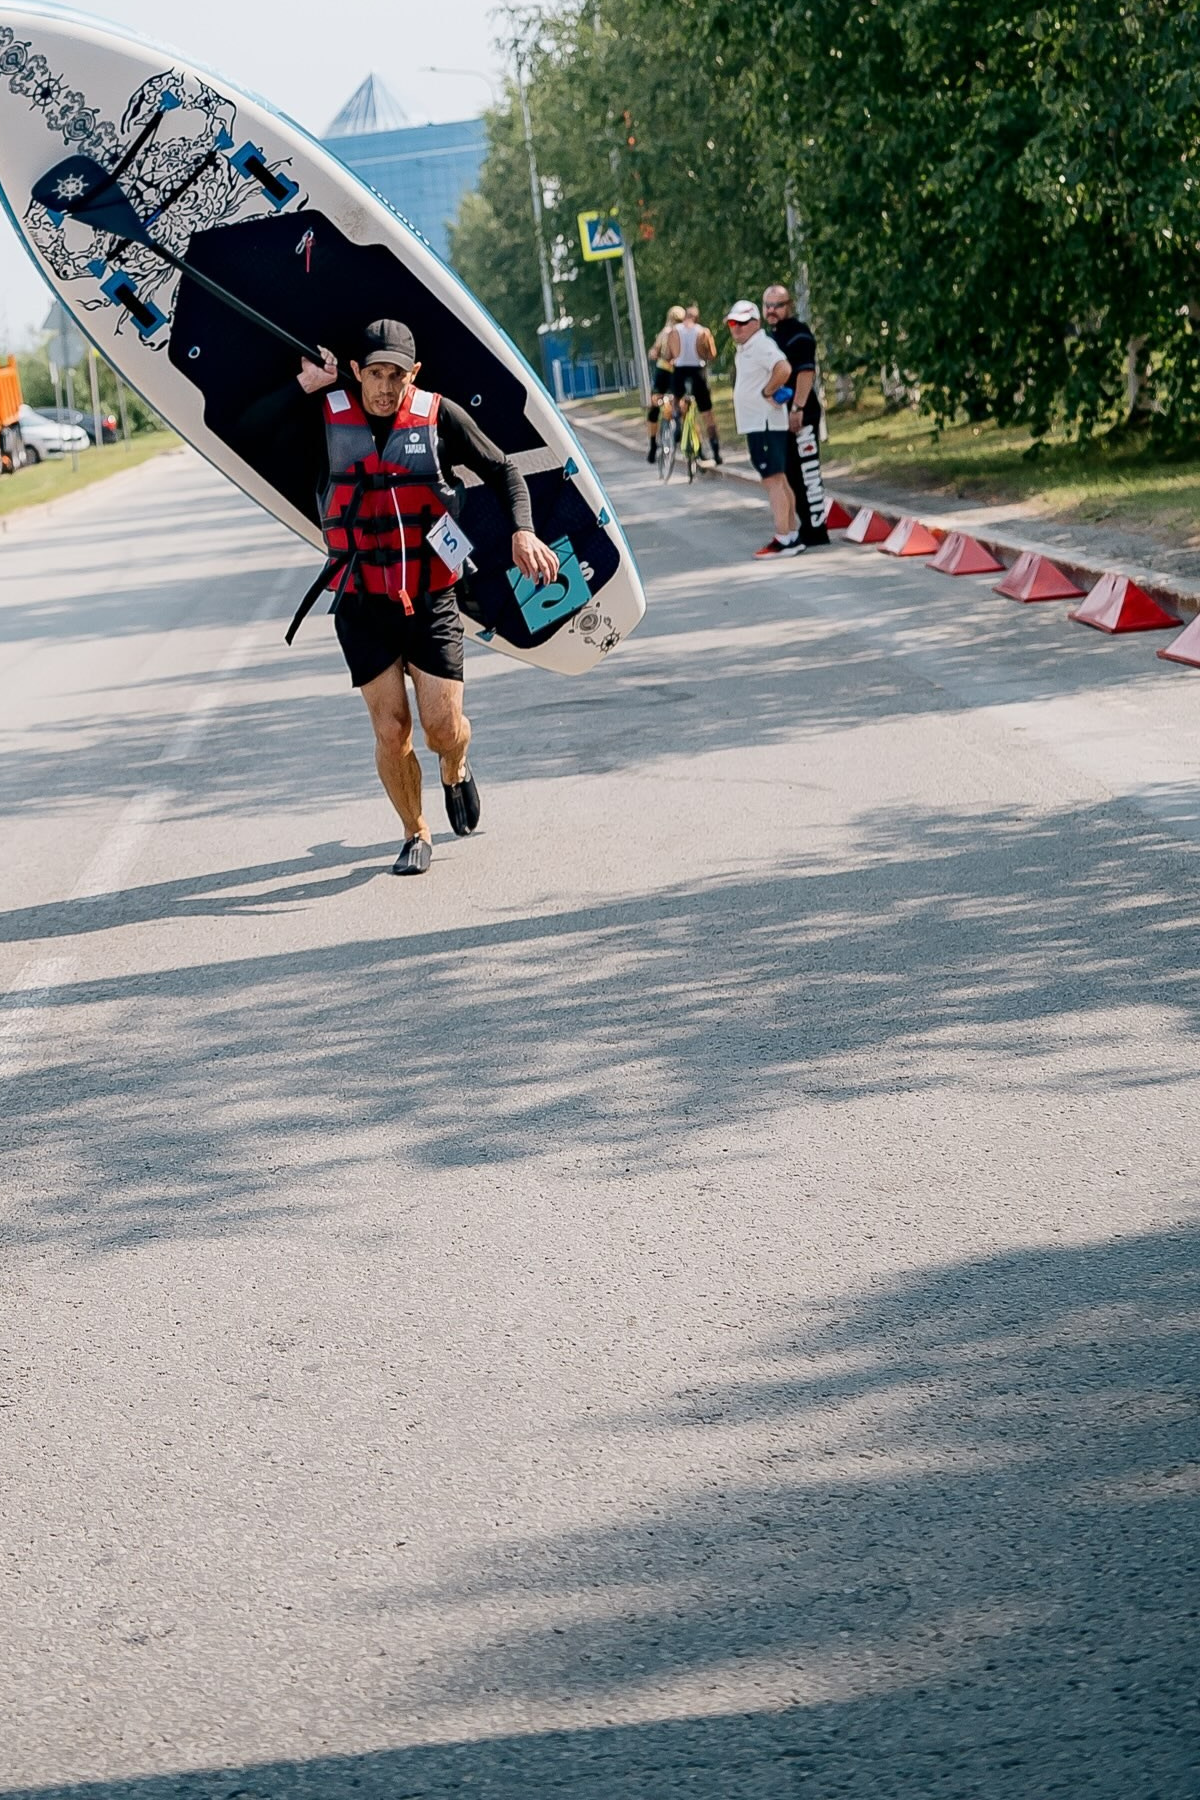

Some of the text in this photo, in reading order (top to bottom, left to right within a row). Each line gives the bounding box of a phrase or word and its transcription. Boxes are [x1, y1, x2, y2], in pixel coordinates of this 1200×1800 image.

[796, 424, 826, 528] NO LIMITS
[442, 531, 458, 553] 5
